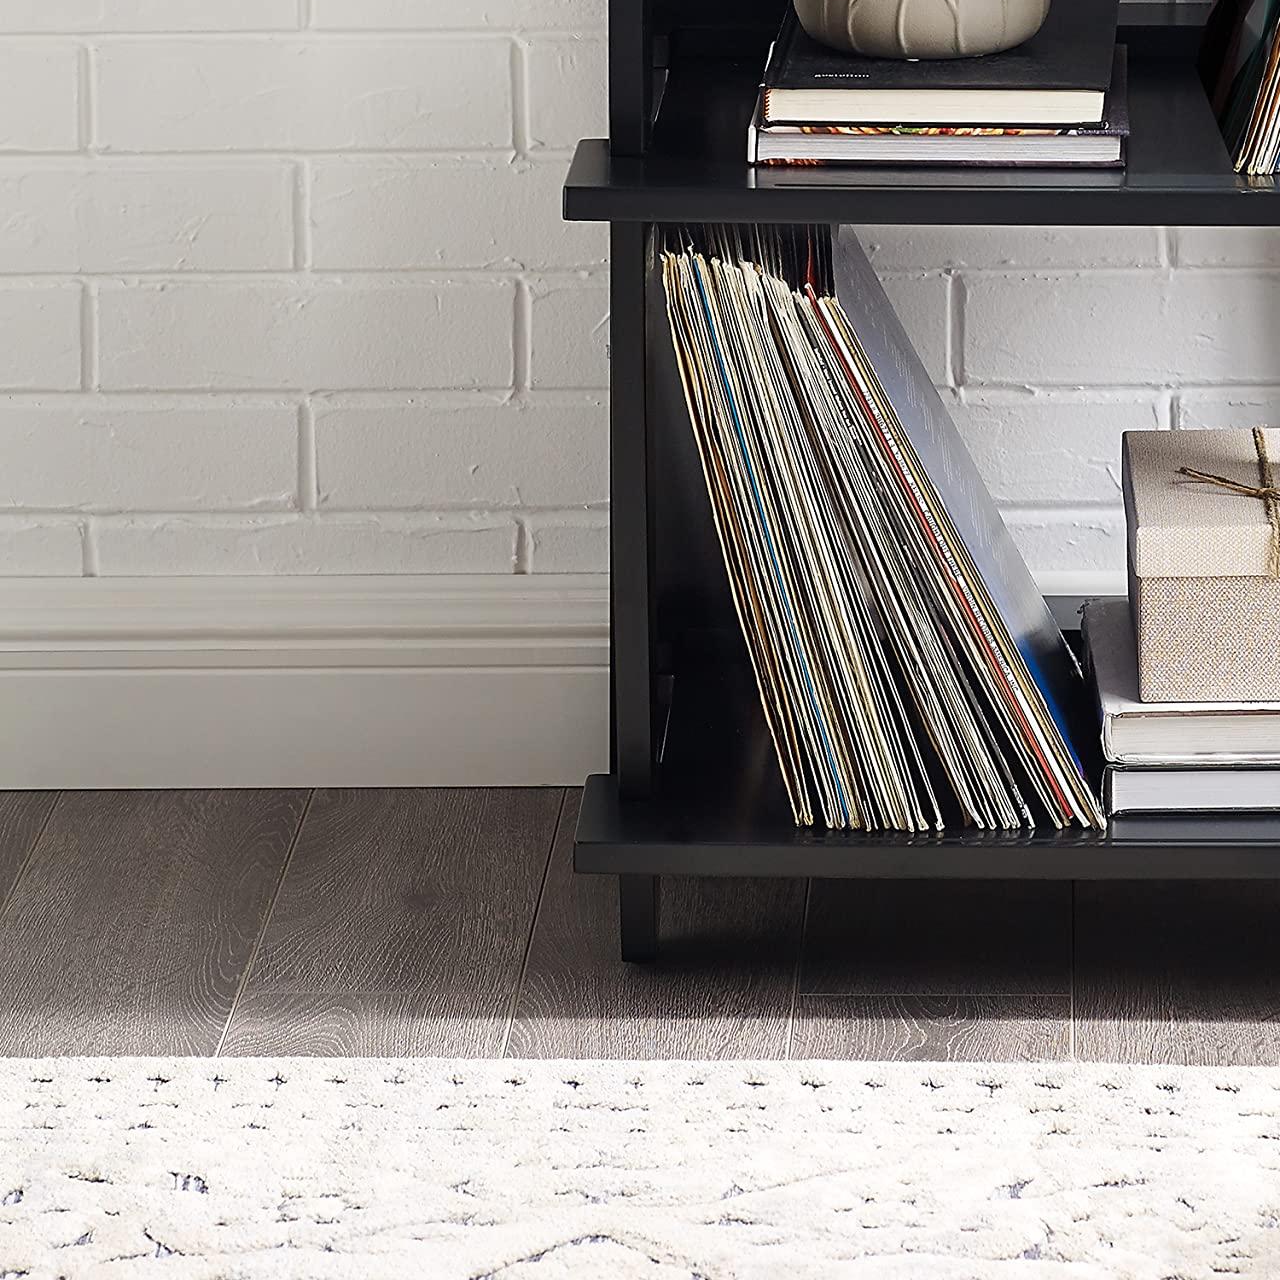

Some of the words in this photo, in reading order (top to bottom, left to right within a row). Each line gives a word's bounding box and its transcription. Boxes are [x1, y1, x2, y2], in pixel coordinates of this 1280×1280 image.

[922, 508, 942, 538] CAUGHT
[938, 538, 950, 553] OUT
[946, 554, 962, 578] THERE
[974, 609, 996, 643] RECORDS
